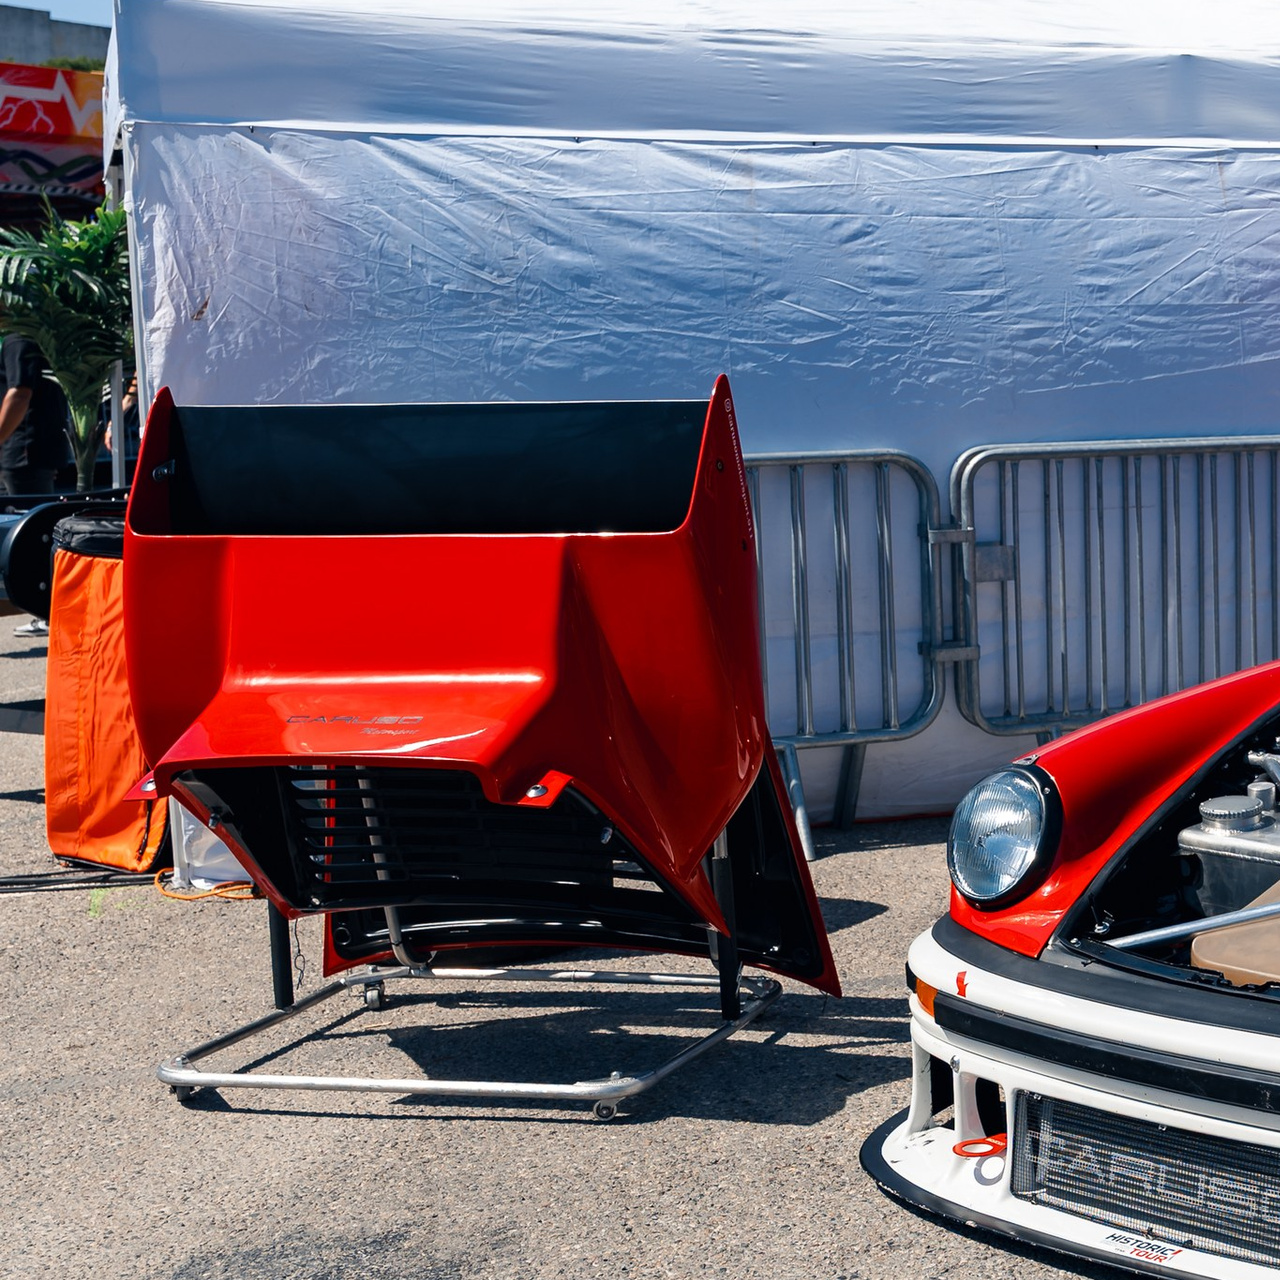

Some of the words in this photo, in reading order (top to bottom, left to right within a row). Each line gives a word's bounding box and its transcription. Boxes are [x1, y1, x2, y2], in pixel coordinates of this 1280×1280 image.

[286, 715, 424, 725] CARUSO
[1105, 1232, 1175, 1256] HISTORIC
[1129, 1247, 1168, 1263] TOUR
